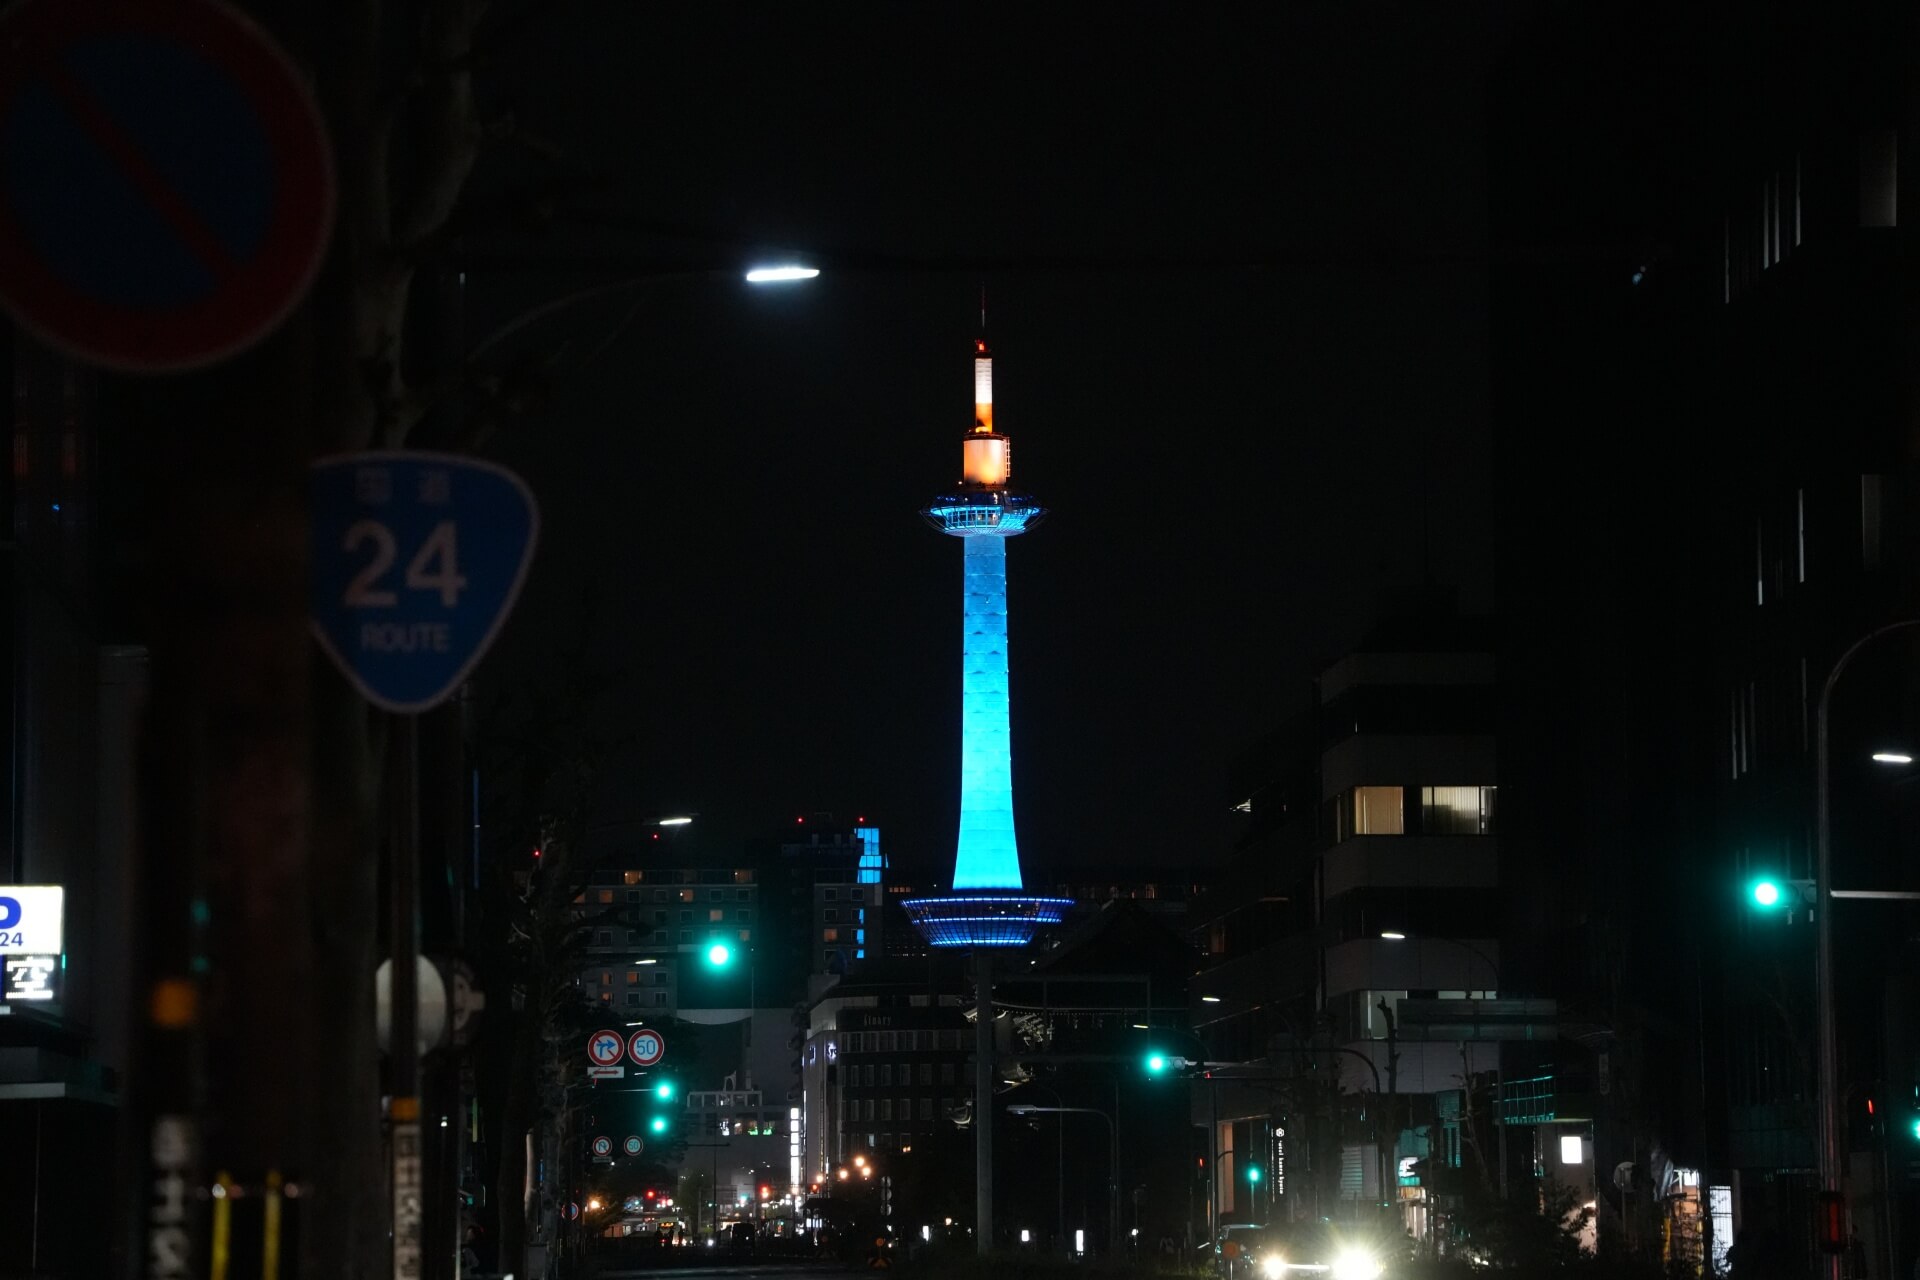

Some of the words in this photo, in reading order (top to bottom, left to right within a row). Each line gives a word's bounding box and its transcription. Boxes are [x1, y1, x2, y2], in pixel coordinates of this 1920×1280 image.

[343, 518, 468, 609] 24
[361, 621, 450, 654] ROUTE
[636, 1039, 656, 1056] 50
